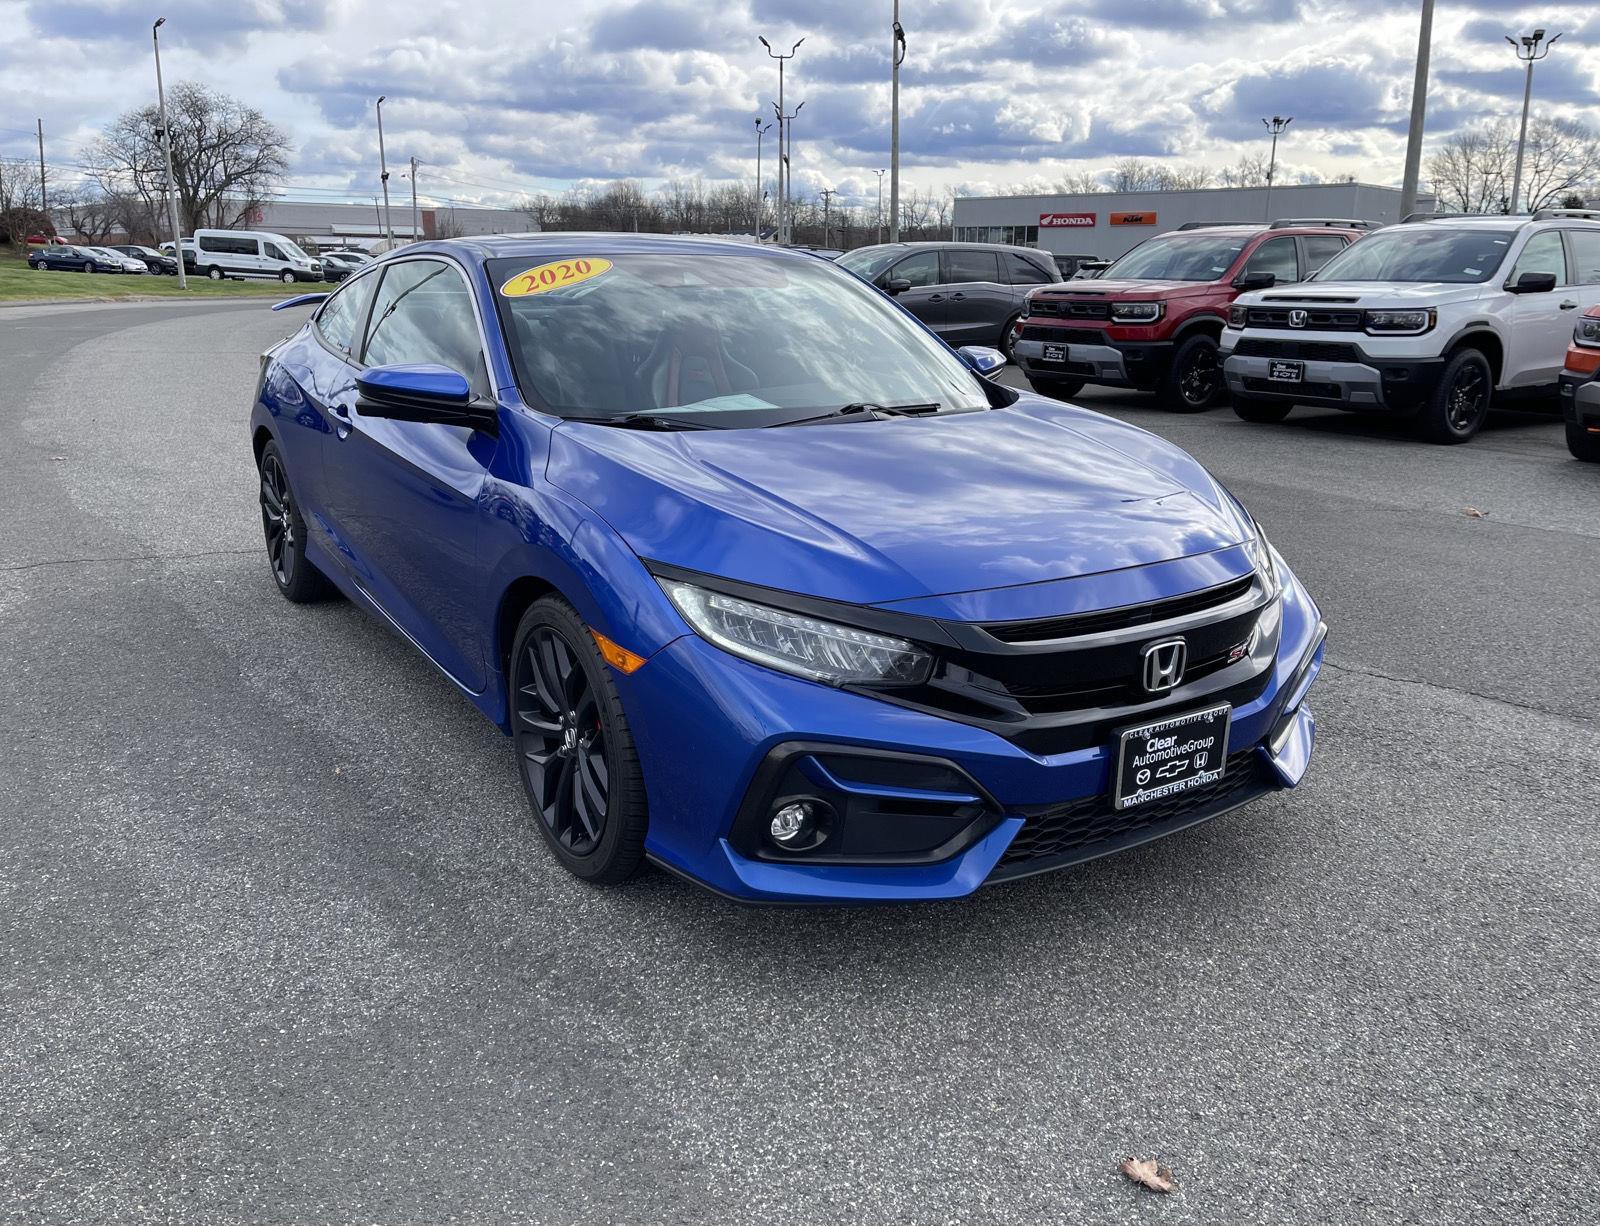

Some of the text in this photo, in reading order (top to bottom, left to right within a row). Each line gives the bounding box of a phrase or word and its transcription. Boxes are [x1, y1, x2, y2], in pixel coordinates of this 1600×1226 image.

[521, 260, 592, 292] 2020
[1129, 708, 1228, 739] CLEAR AUTOMOTIVE GROUP
[1132, 736, 1215, 768] AutomotiveGroup
[1146, 735, 1178, 752] Clear
[1123, 772, 1219, 807] MANCHESTER HONDA
